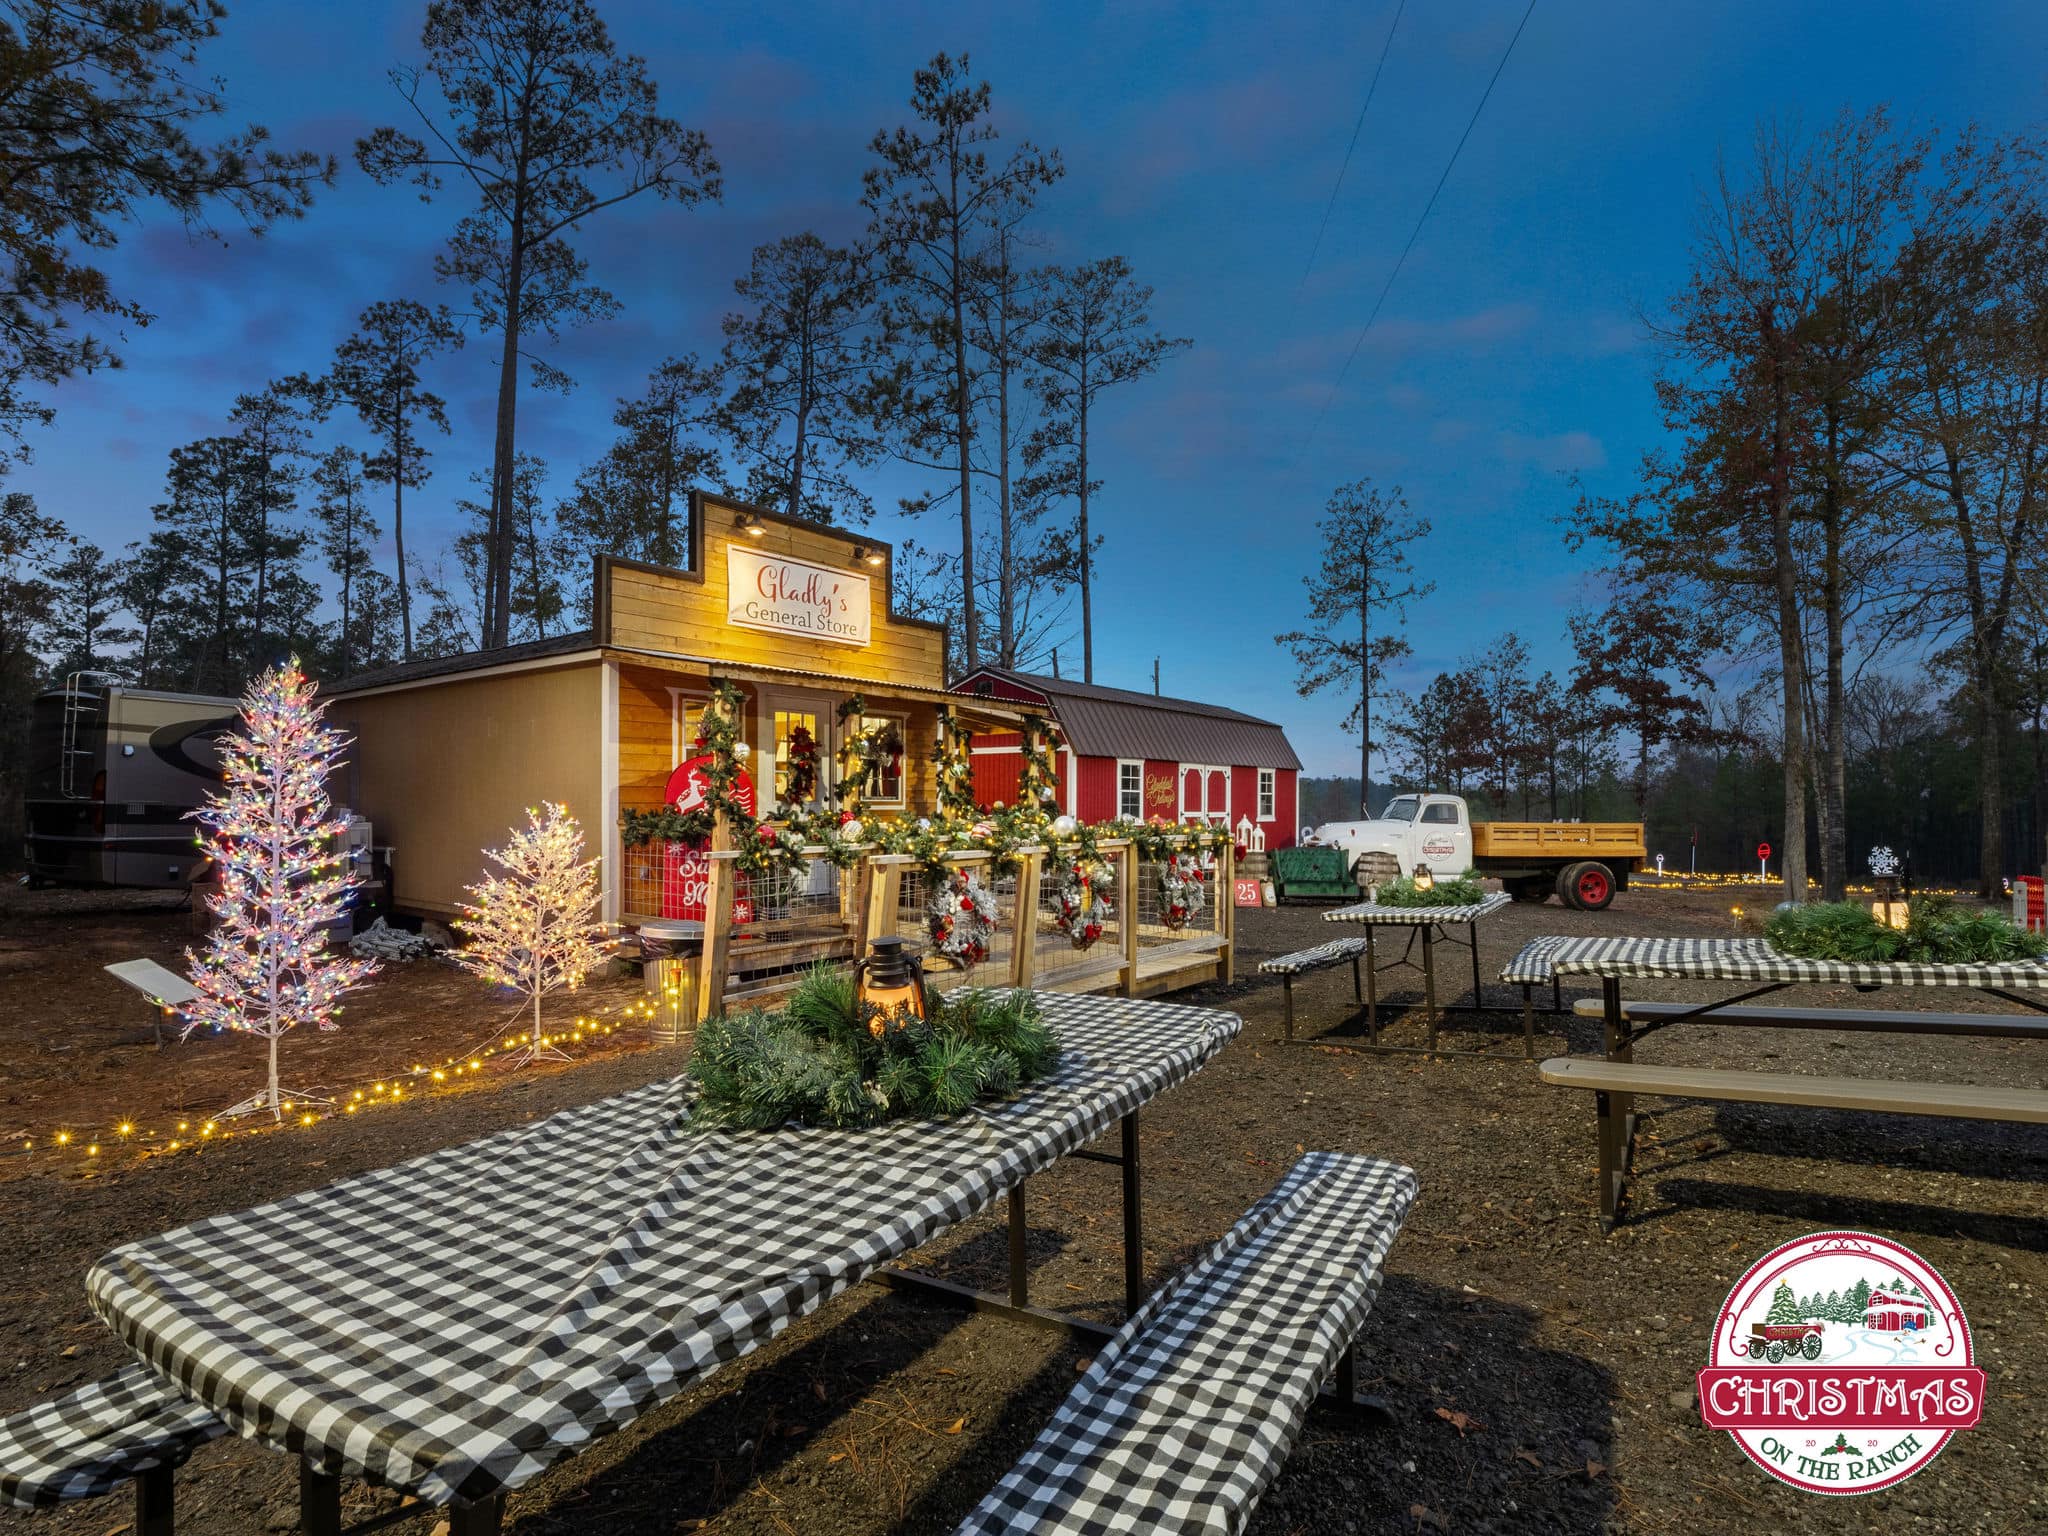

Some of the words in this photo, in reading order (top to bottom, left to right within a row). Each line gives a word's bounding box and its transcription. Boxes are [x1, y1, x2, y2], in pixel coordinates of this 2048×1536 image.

[757, 564, 848, 617] Gladly's
[745, 601, 812, 628] General
[816, 613, 857, 636] Store
[1237, 883, 1257, 901] 25
